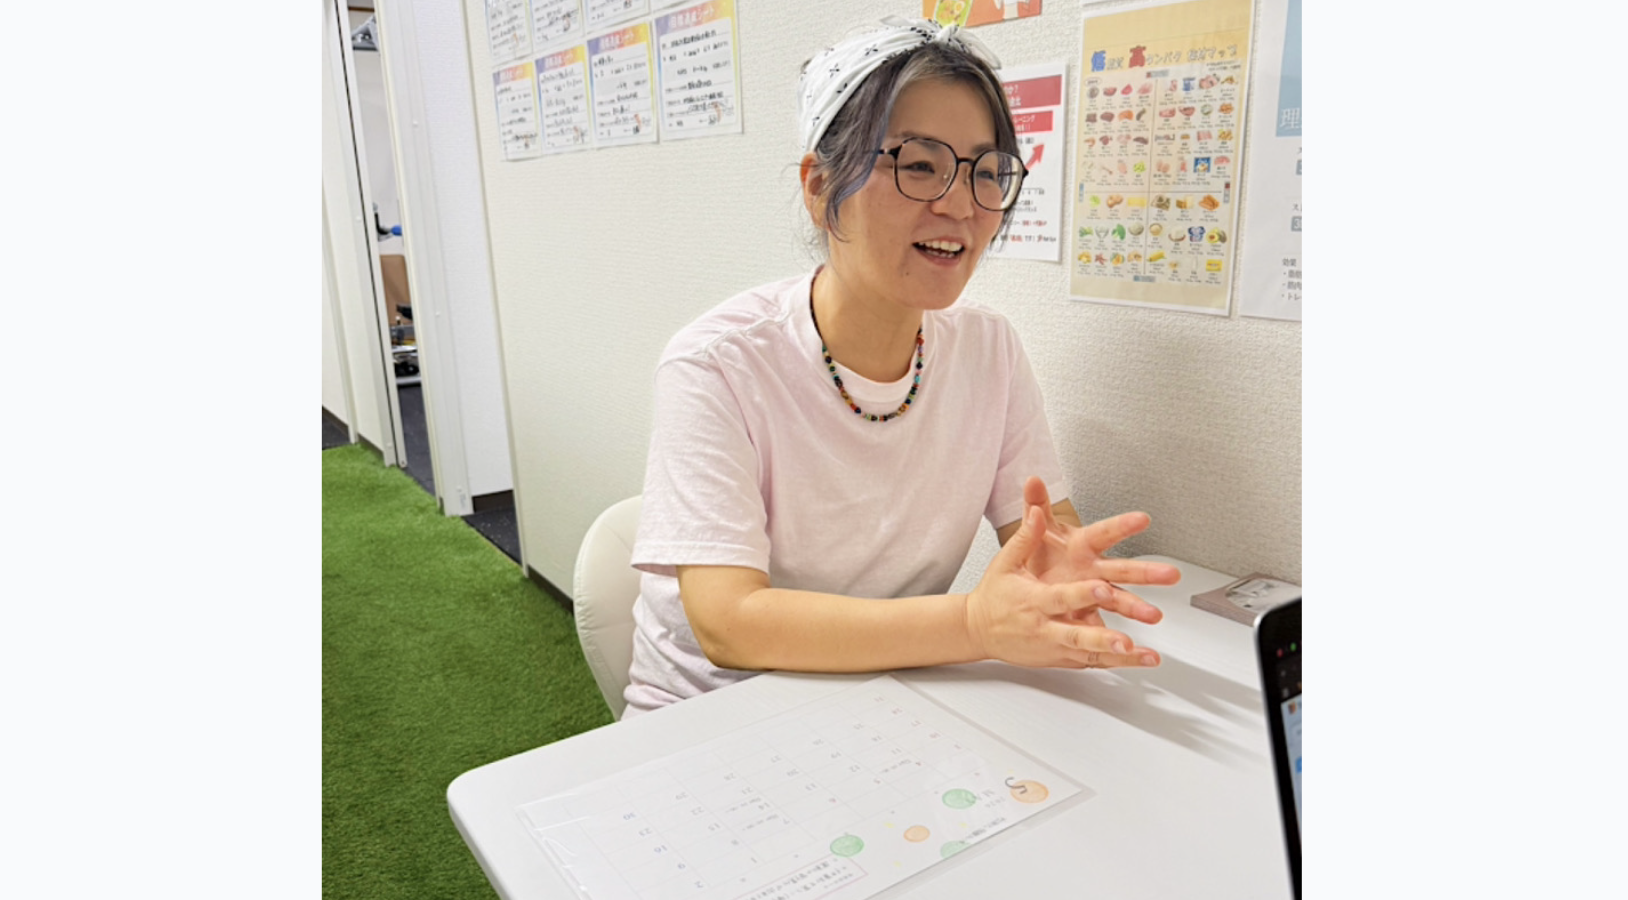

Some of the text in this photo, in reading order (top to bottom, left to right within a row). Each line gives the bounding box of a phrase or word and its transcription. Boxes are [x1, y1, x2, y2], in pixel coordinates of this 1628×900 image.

[1280, 107, 1302, 129] 理
[1282, 258, 1297, 267] 効果
[1004, 776, 1028, 794] 5
